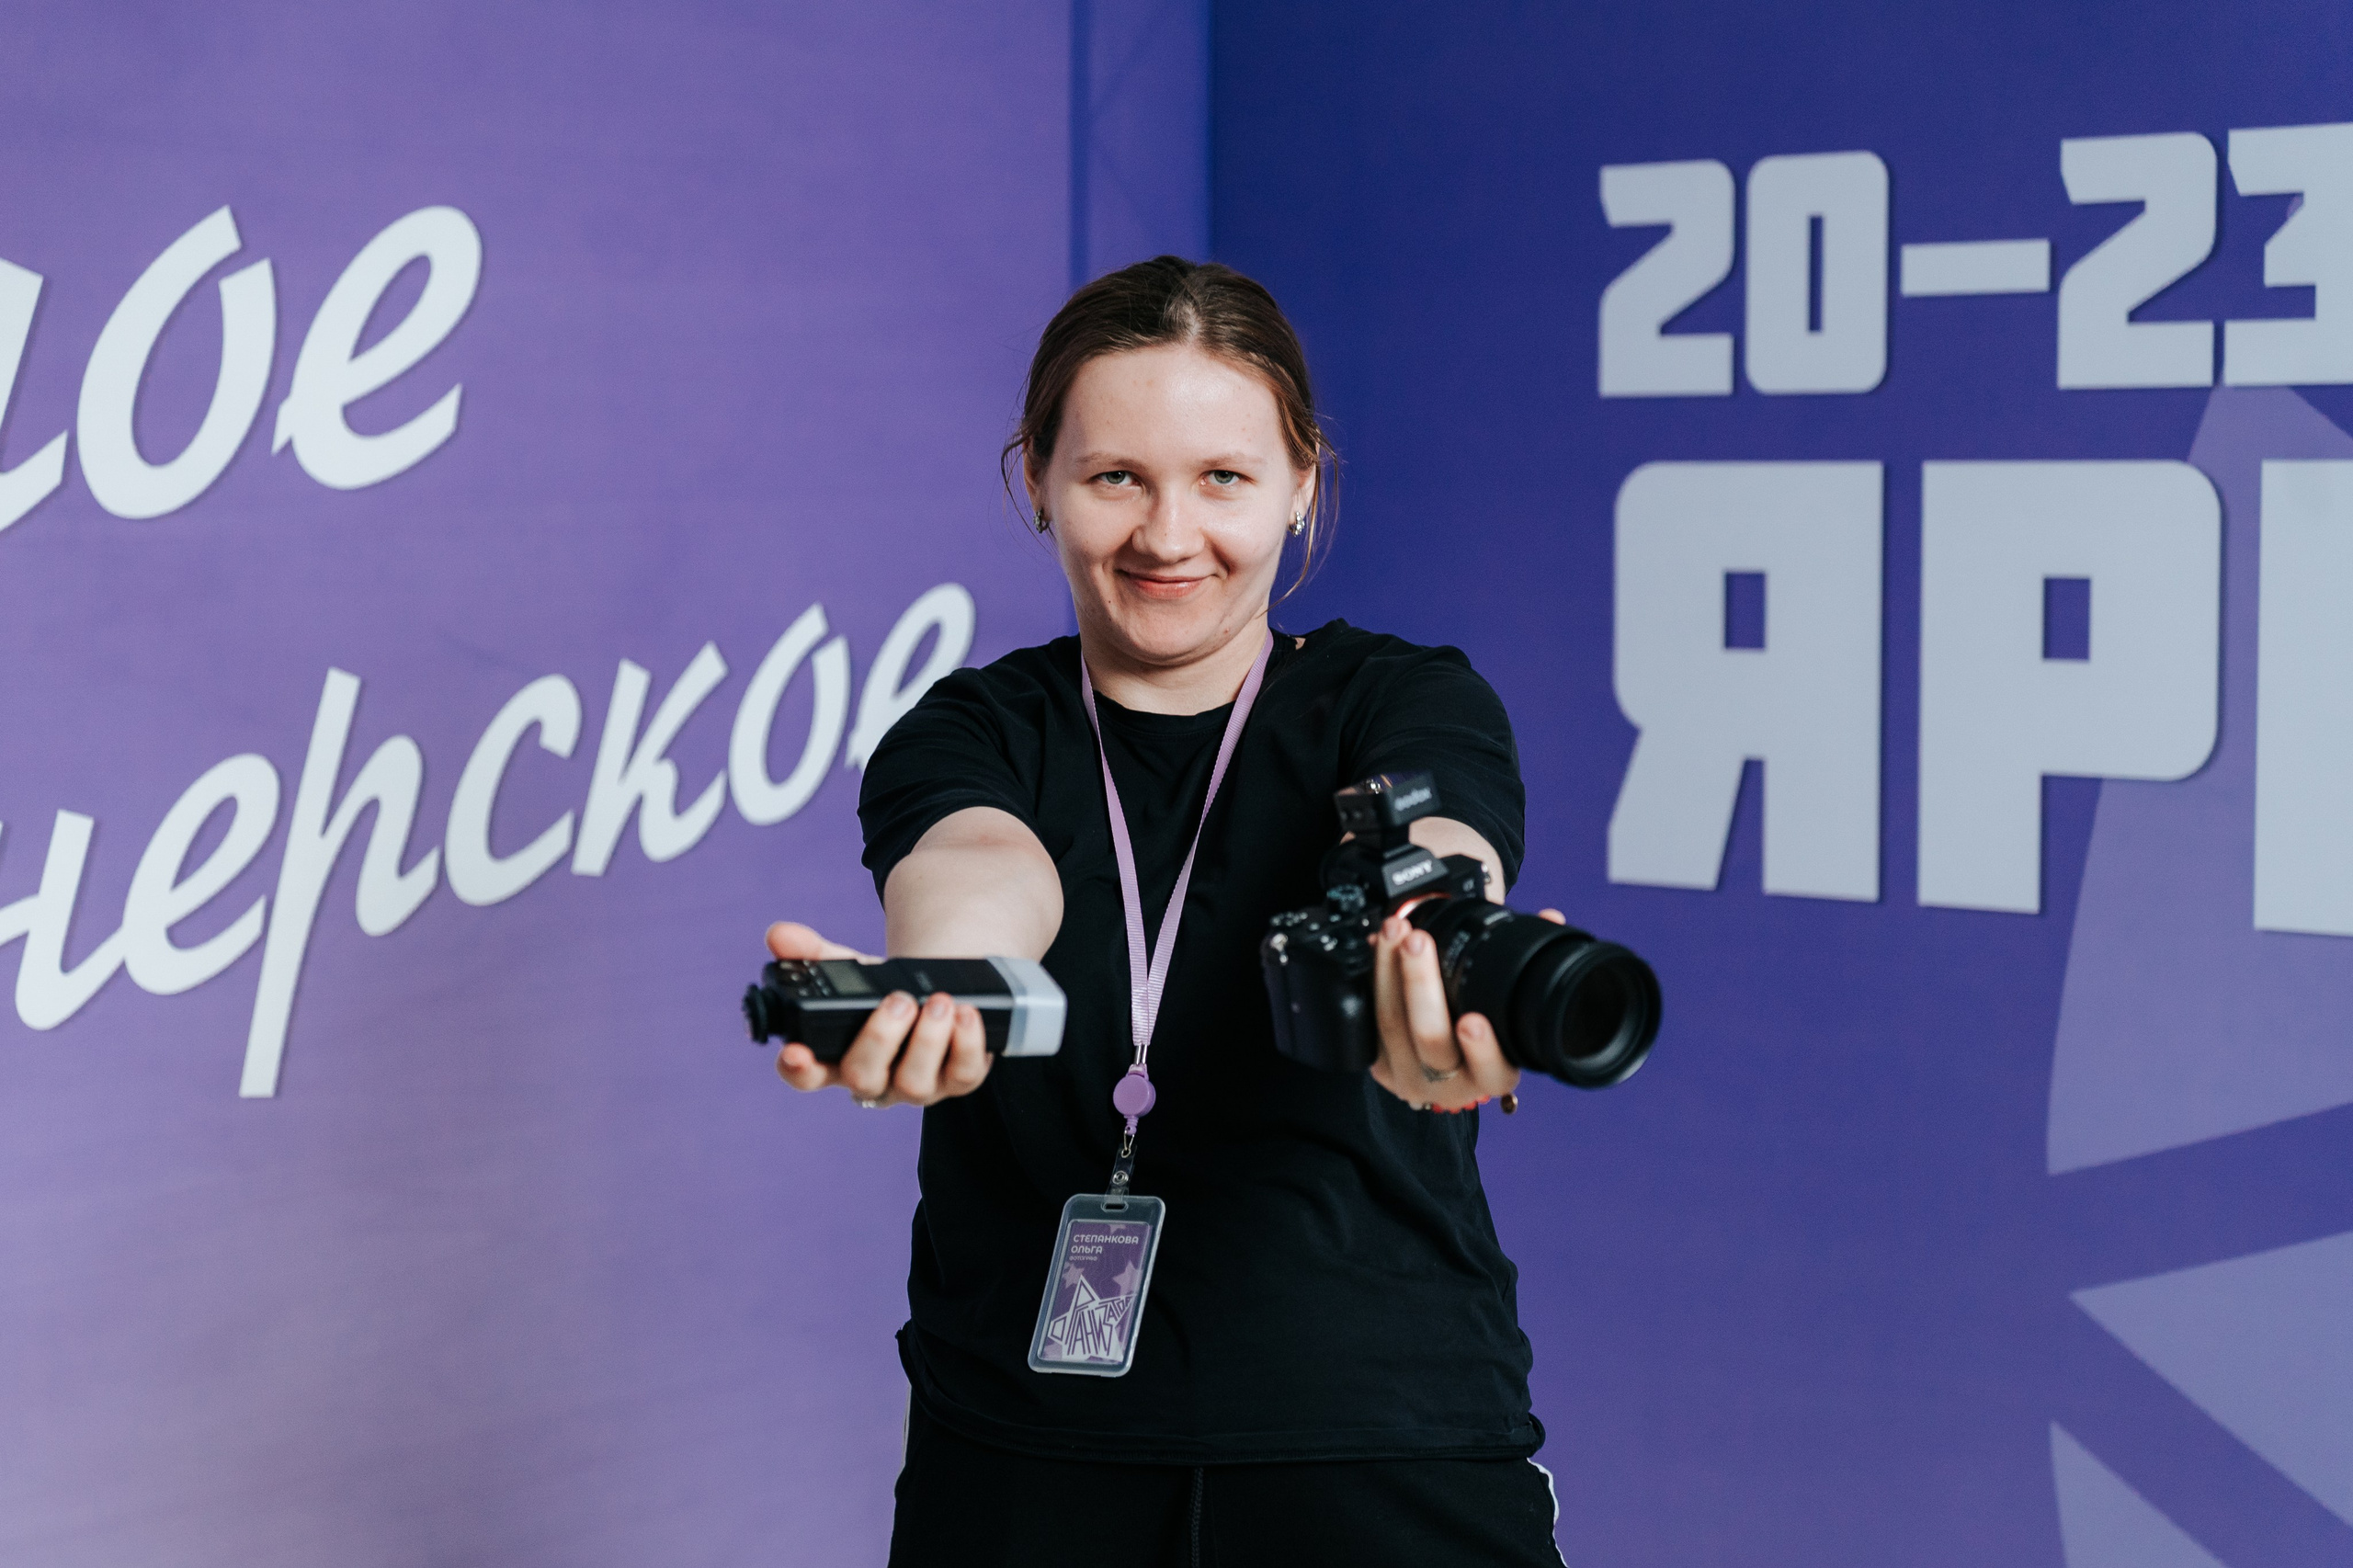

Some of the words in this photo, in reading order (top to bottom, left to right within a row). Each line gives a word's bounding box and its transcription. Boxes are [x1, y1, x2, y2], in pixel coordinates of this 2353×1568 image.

[1392, 858, 1433, 885] SONY
[1073, 1233, 1140, 1244] СТЕПАНКОВА
[1071, 1244, 1103, 1255] ОЛЬГА
